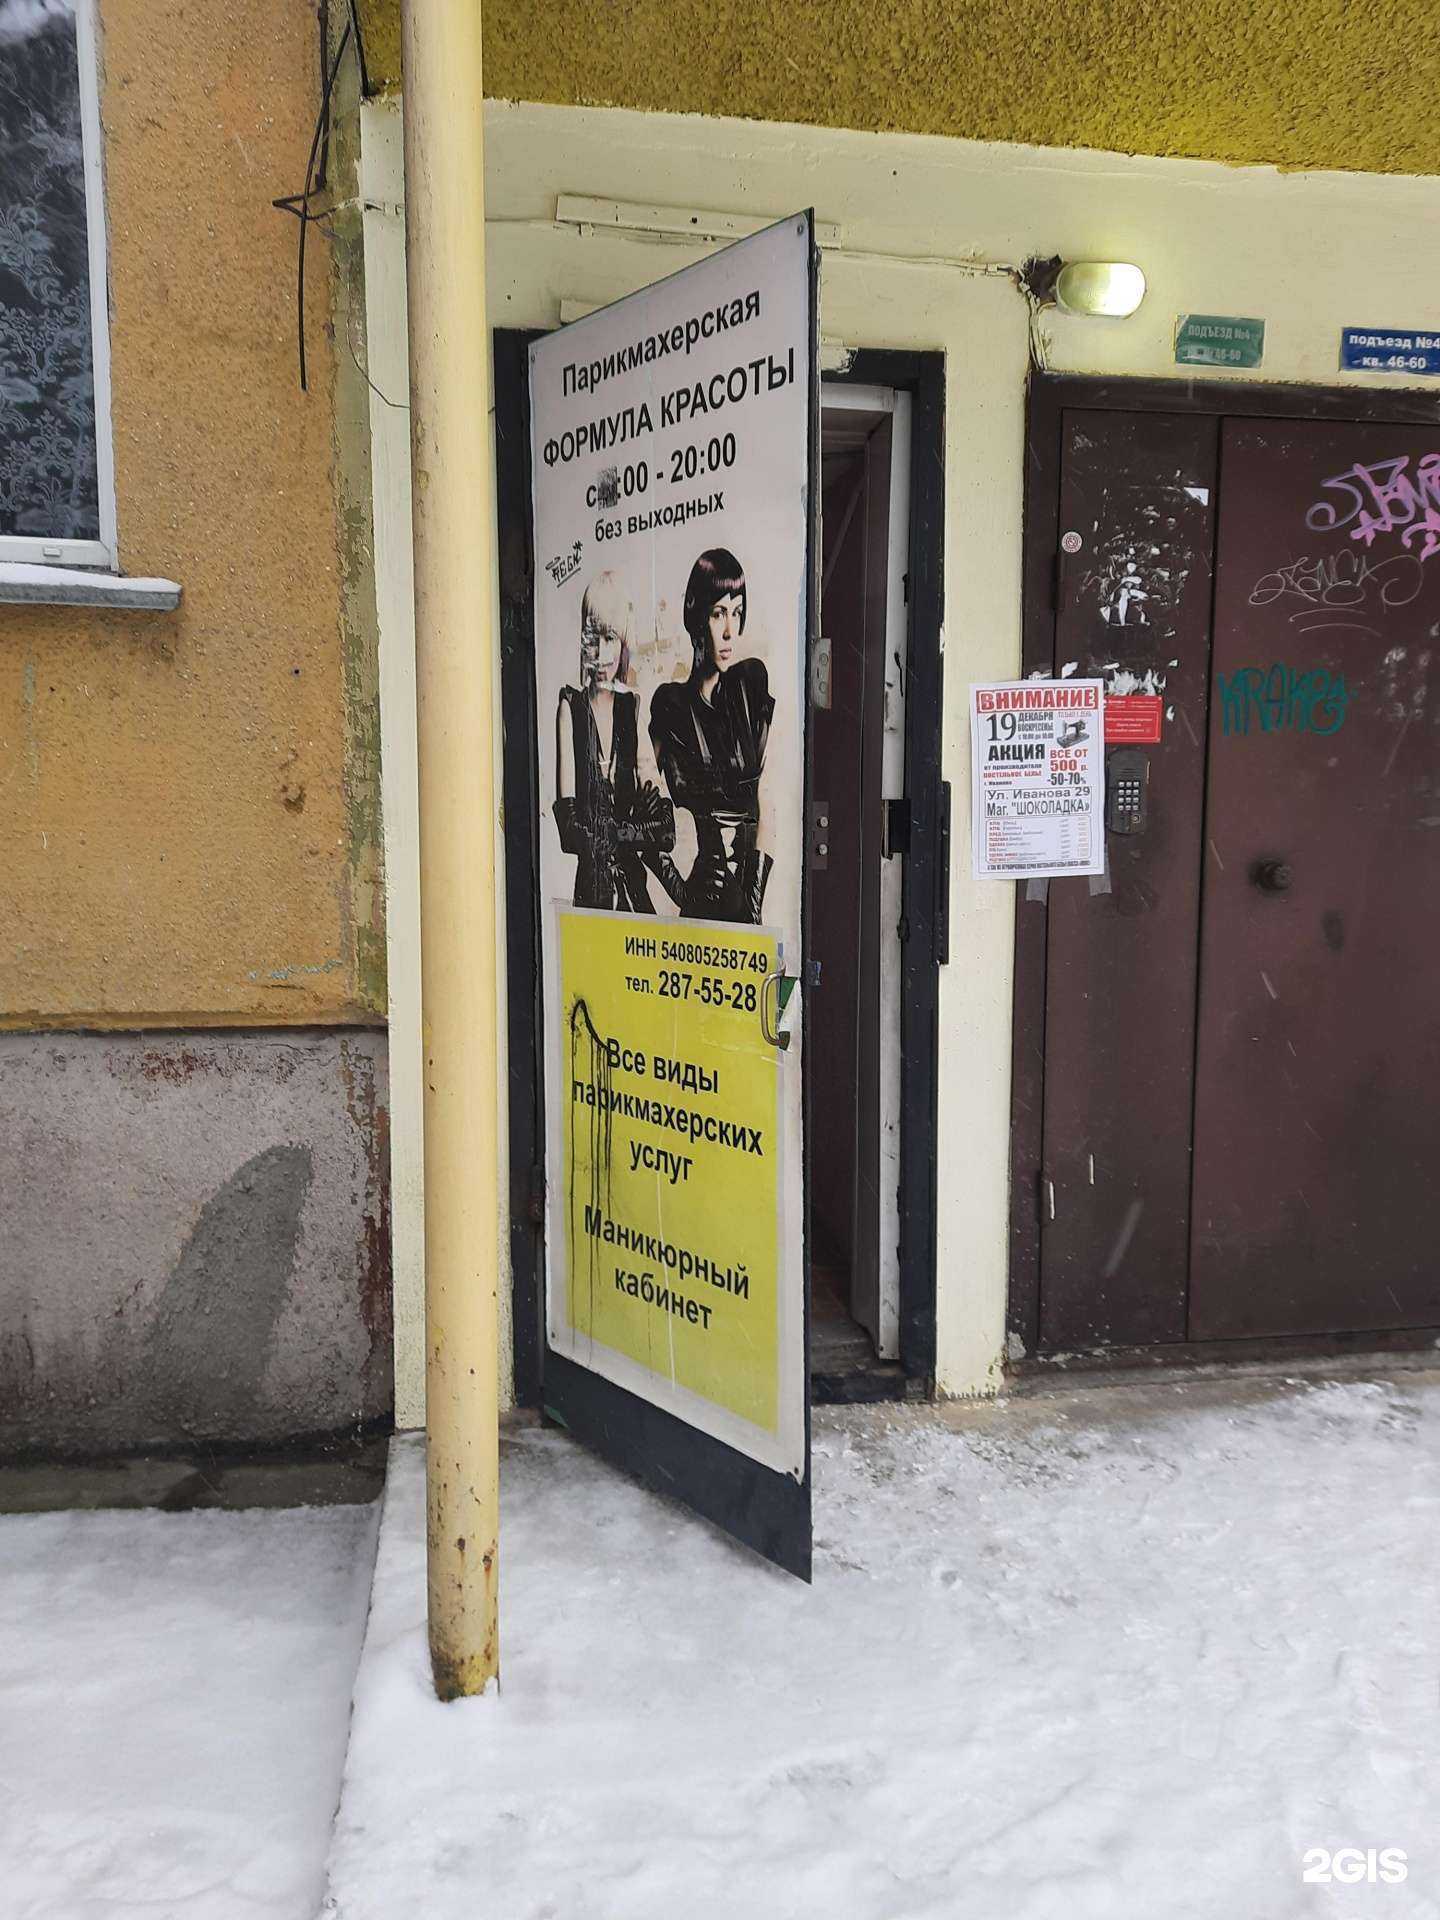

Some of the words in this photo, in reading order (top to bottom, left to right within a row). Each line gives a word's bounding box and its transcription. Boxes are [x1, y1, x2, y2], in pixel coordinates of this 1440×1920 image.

[563, 290, 760, 397] Парикмахерская
[1188, 325, 1233, 340] ПОДЪЕЗД
[1348, 334, 1412, 350] подъезд
[1415, 336, 1440, 350] №4
[1362, 356, 1384, 367] кв.
[1387, 355, 1427, 369] 46-60
[543, 402, 654, 468] ФОРМУЛА
[660, 347, 794, 428] КРАСОТЫ
[670, 432, 736, 484] 20:00
[595, 518, 622, 542] без
[628, 491, 724, 534] выходных
[979, 688, 1096, 711] ВНИМАНИЕ
[986, 712, 1017, 741] 19
[1018, 711, 1054, 722] ДЕКАБРЯ
[988, 743, 1046, 763] АКЦИЯ
[1049, 749, 1072, 759] ВСЕ
[1074, 748, 1089, 758] ОТ
[1049, 759, 1078, 772] 500
[987, 790, 1009, 800] Ул.
[1013, 789, 1071, 799] Иванова
[1075, 786, 1091, 796] 29
[987, 802, 1009, 816] Маг.
[624, 936, 656, 959] ИНН
[661, 941, 768, 974] 540805258749
[625, 975, 654, 994] тел.
[658, 970, 757, 1012] 287-55-28
[606, 1037, 646, 1076] Все
[653, 1055, 719, 1094] виды
[573, 1080, 764, 1156] парикмахерских
[629, 1140, 693, 1185] услуг
[584, 1204, 750, 1300] Маникюрный
[614, 1267, 712, 1330] кабинет
